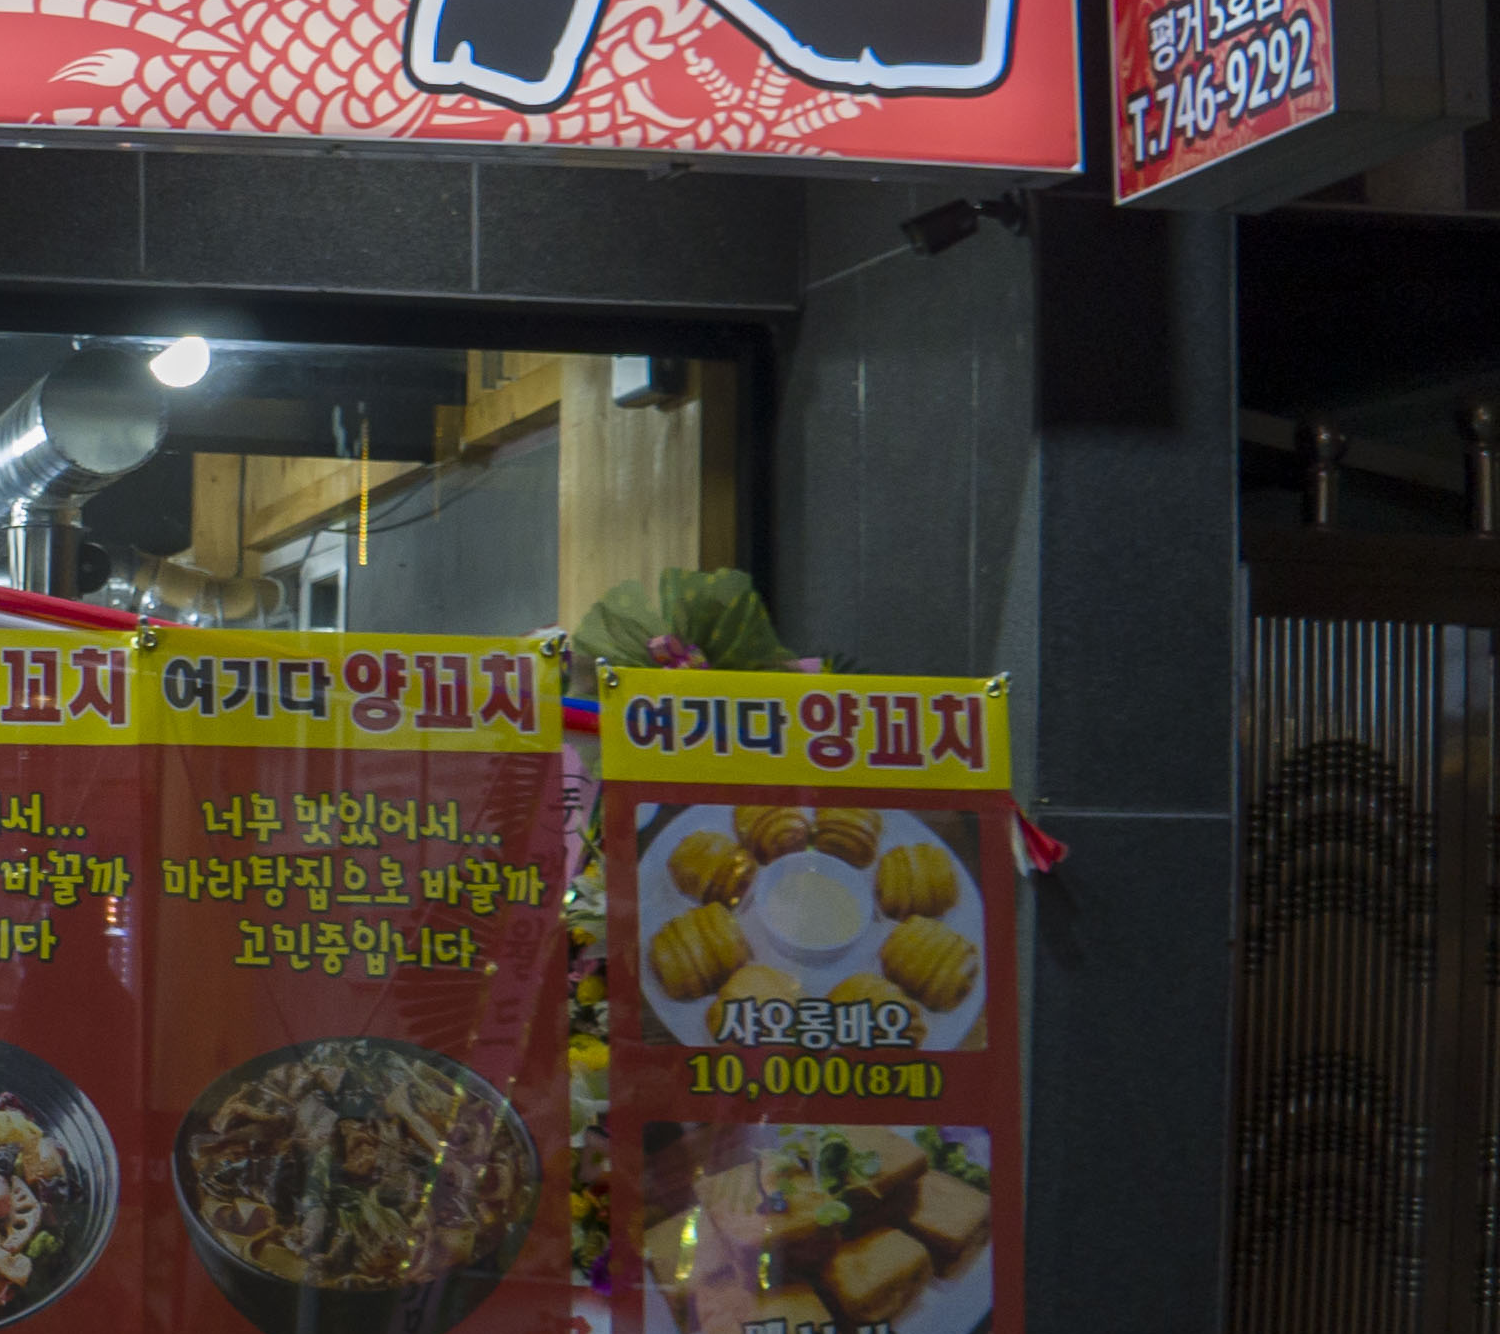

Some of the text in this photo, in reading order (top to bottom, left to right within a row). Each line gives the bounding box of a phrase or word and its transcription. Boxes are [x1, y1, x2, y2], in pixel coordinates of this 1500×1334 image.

[1126, 16, 1315, 165] T.746-9292
[162, 649, 540, 734] 여기다 양꼬치
[625, 692, 988, 772] 여기다 양꼬치
[201, 796, 285, 841] 너무
[161, 856, 410, 912] 마라탕집으로
[233, 918, 478, 978] 고민중입니다
[717, 998, 915, 1050] 샤오롱바오
[687, 1053, 944, 1101] 10,000(8개)
